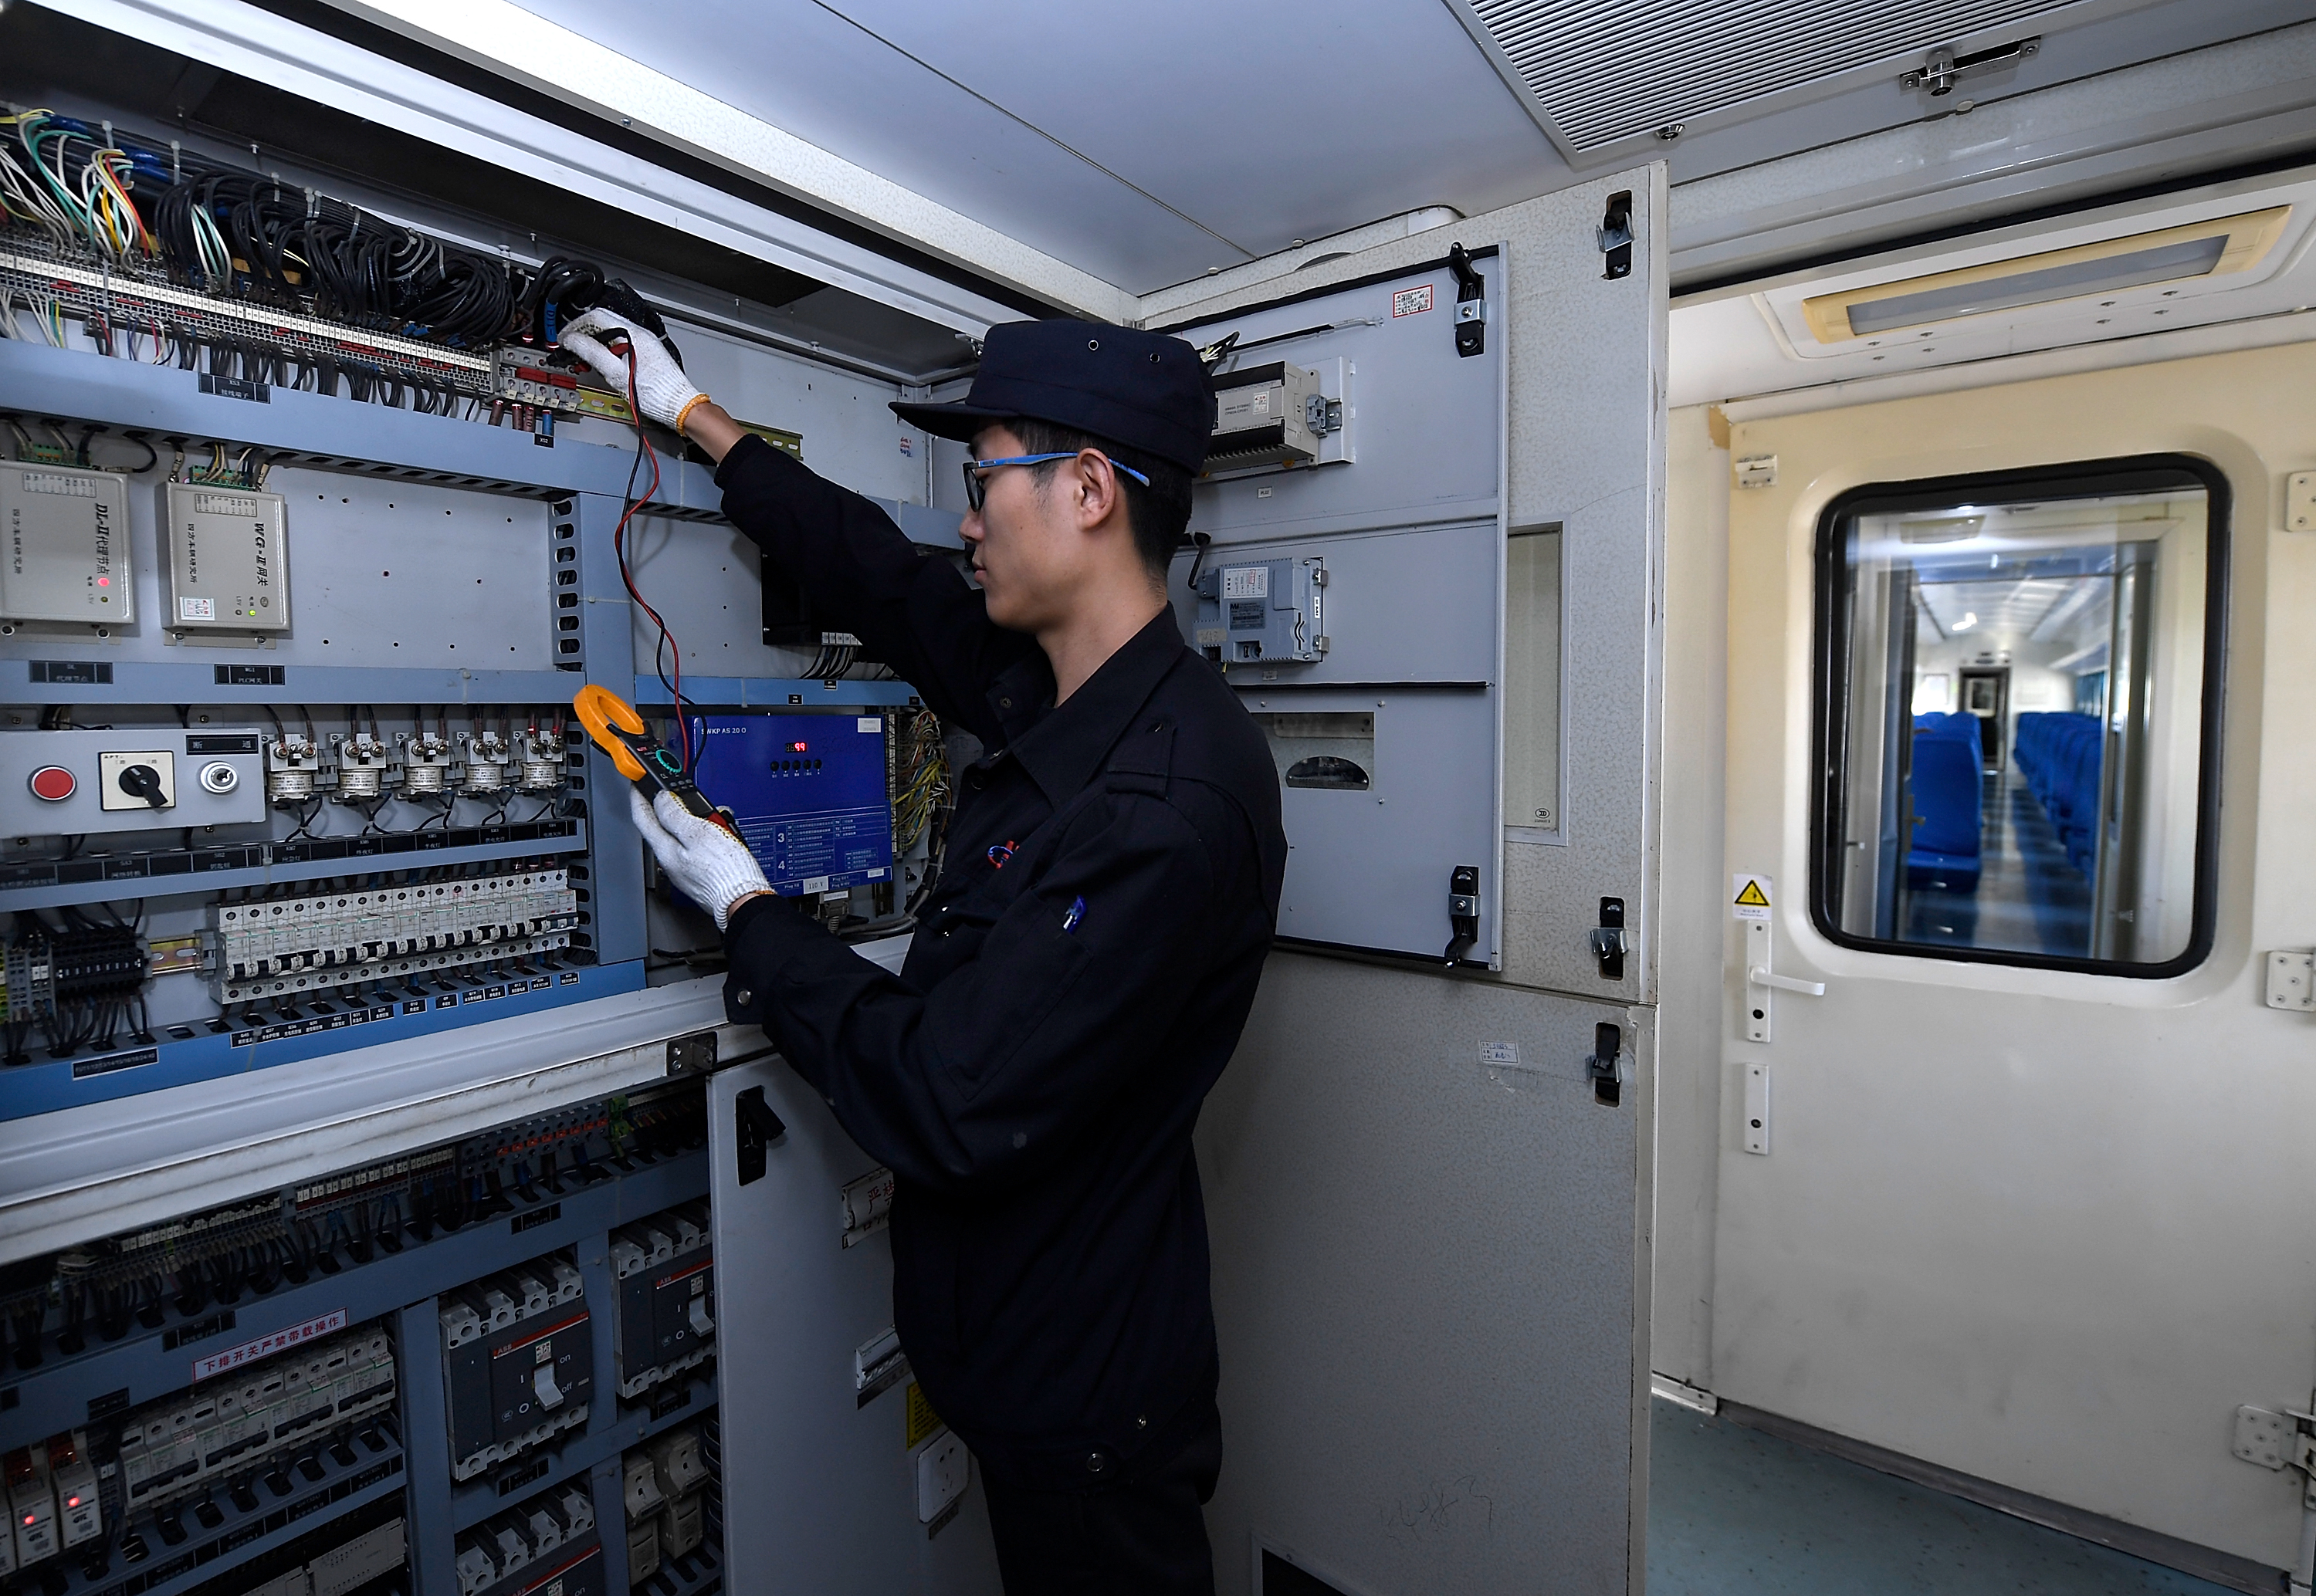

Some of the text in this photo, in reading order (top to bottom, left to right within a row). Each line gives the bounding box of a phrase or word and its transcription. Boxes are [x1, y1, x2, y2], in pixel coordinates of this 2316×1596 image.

[193, 741, 202, 749] 断
[777, 833, 785, 843] 3
[777, 861, 786, 870] 4
[660, 1276, 672, 1286] ABB
[204, 1316, 340, 1372] 下排开关严禁带载操作
[498, 1344, 513, 1354] ABB
[560, 1354, 571, 1364] on
[562, 1381, 573, 1394] off
